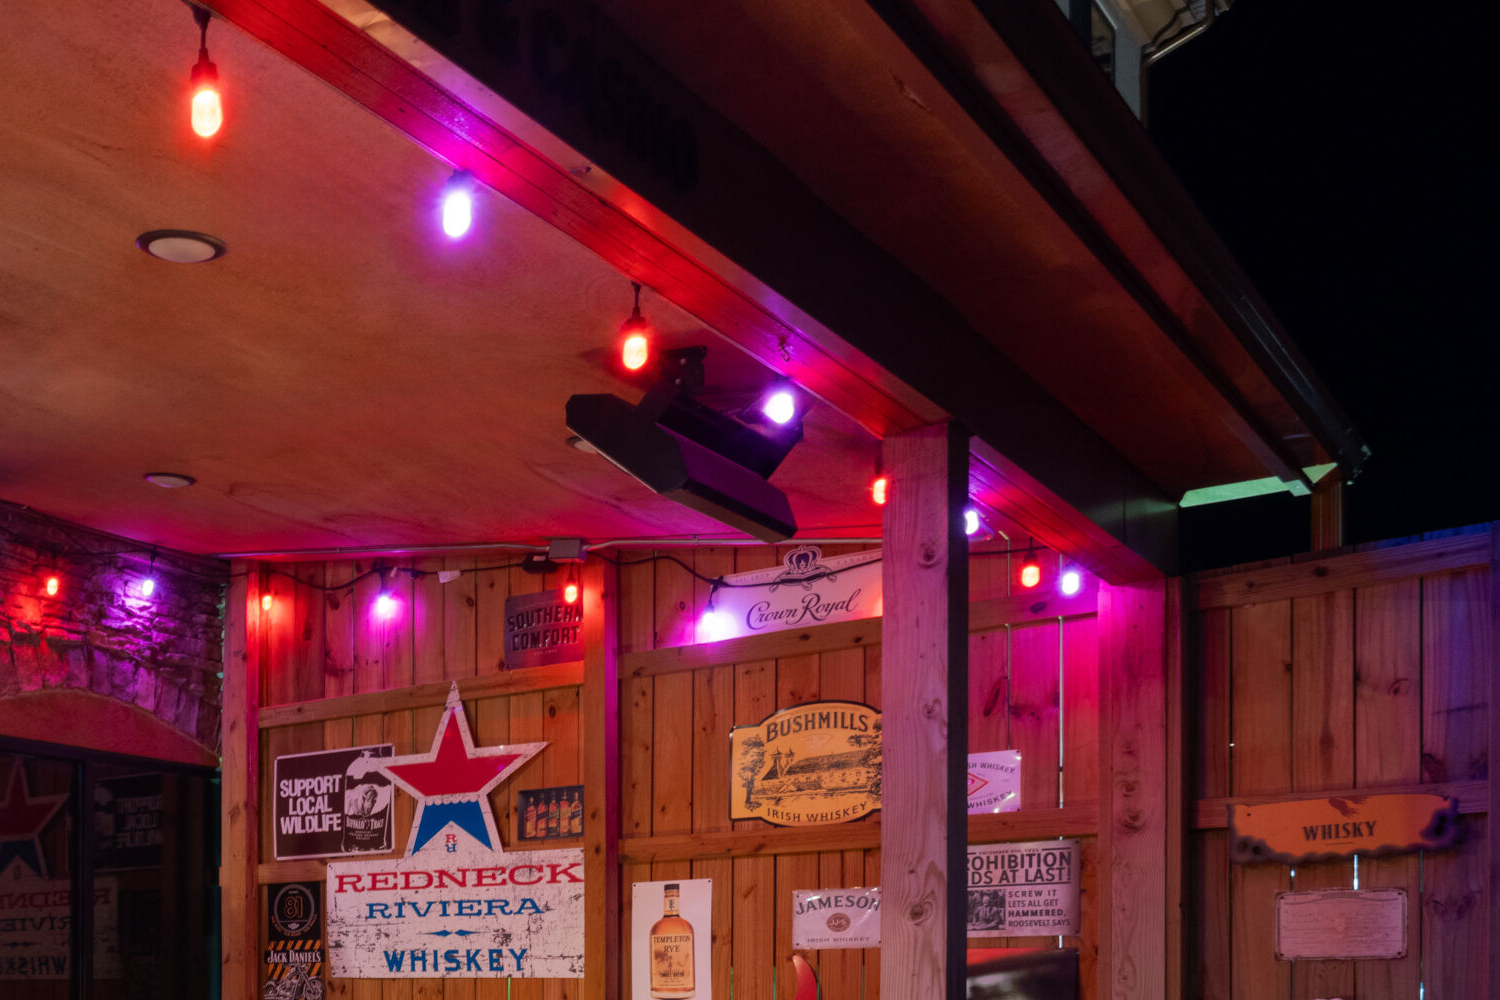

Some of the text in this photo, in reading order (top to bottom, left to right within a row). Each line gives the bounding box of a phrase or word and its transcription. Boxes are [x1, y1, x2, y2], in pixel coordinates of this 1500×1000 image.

[507, 604, 583, 633] SOUTHERN
[746, 588, 862, 630] Crown Royal
[512, 625, 580, 652] COMFORT
[766, 711, 868, 743] BUSHMILLS
[279, 773, 342, 798] SUPPORT
[288, 794, 332, 816] LOCAL
[767, 801, 867, 823] IRISH WHISKEY
[280, 812, 342, 835] WILDLIFE
[1302, 820, 1377, 842] WHISKY
[967, 851, 1071, 871] OHIBITION
[334, 863, 585, 893] REDNECK
[998, 869, 1019, 883] AT
[1025, 867, 1071, 882] LAST!
[1008, 888, 1057, 898] SCREW IT
[1008, 900, 1026, 908] LETS
[1044, 899, 1058, 907] GET
[366, 898, 545, 919] RIVIERA
[796, 895, 880, 915] JAMESON
[1008, 920, 1050, 928] ROOSEVELT
[653, 934, 691, 944] TEMPLETON
[663, 945, 680, 953] RYE
[267, 949, 321, 963] JACK DANIEL'S
[384, 948, 528, 973] WHISKEY
